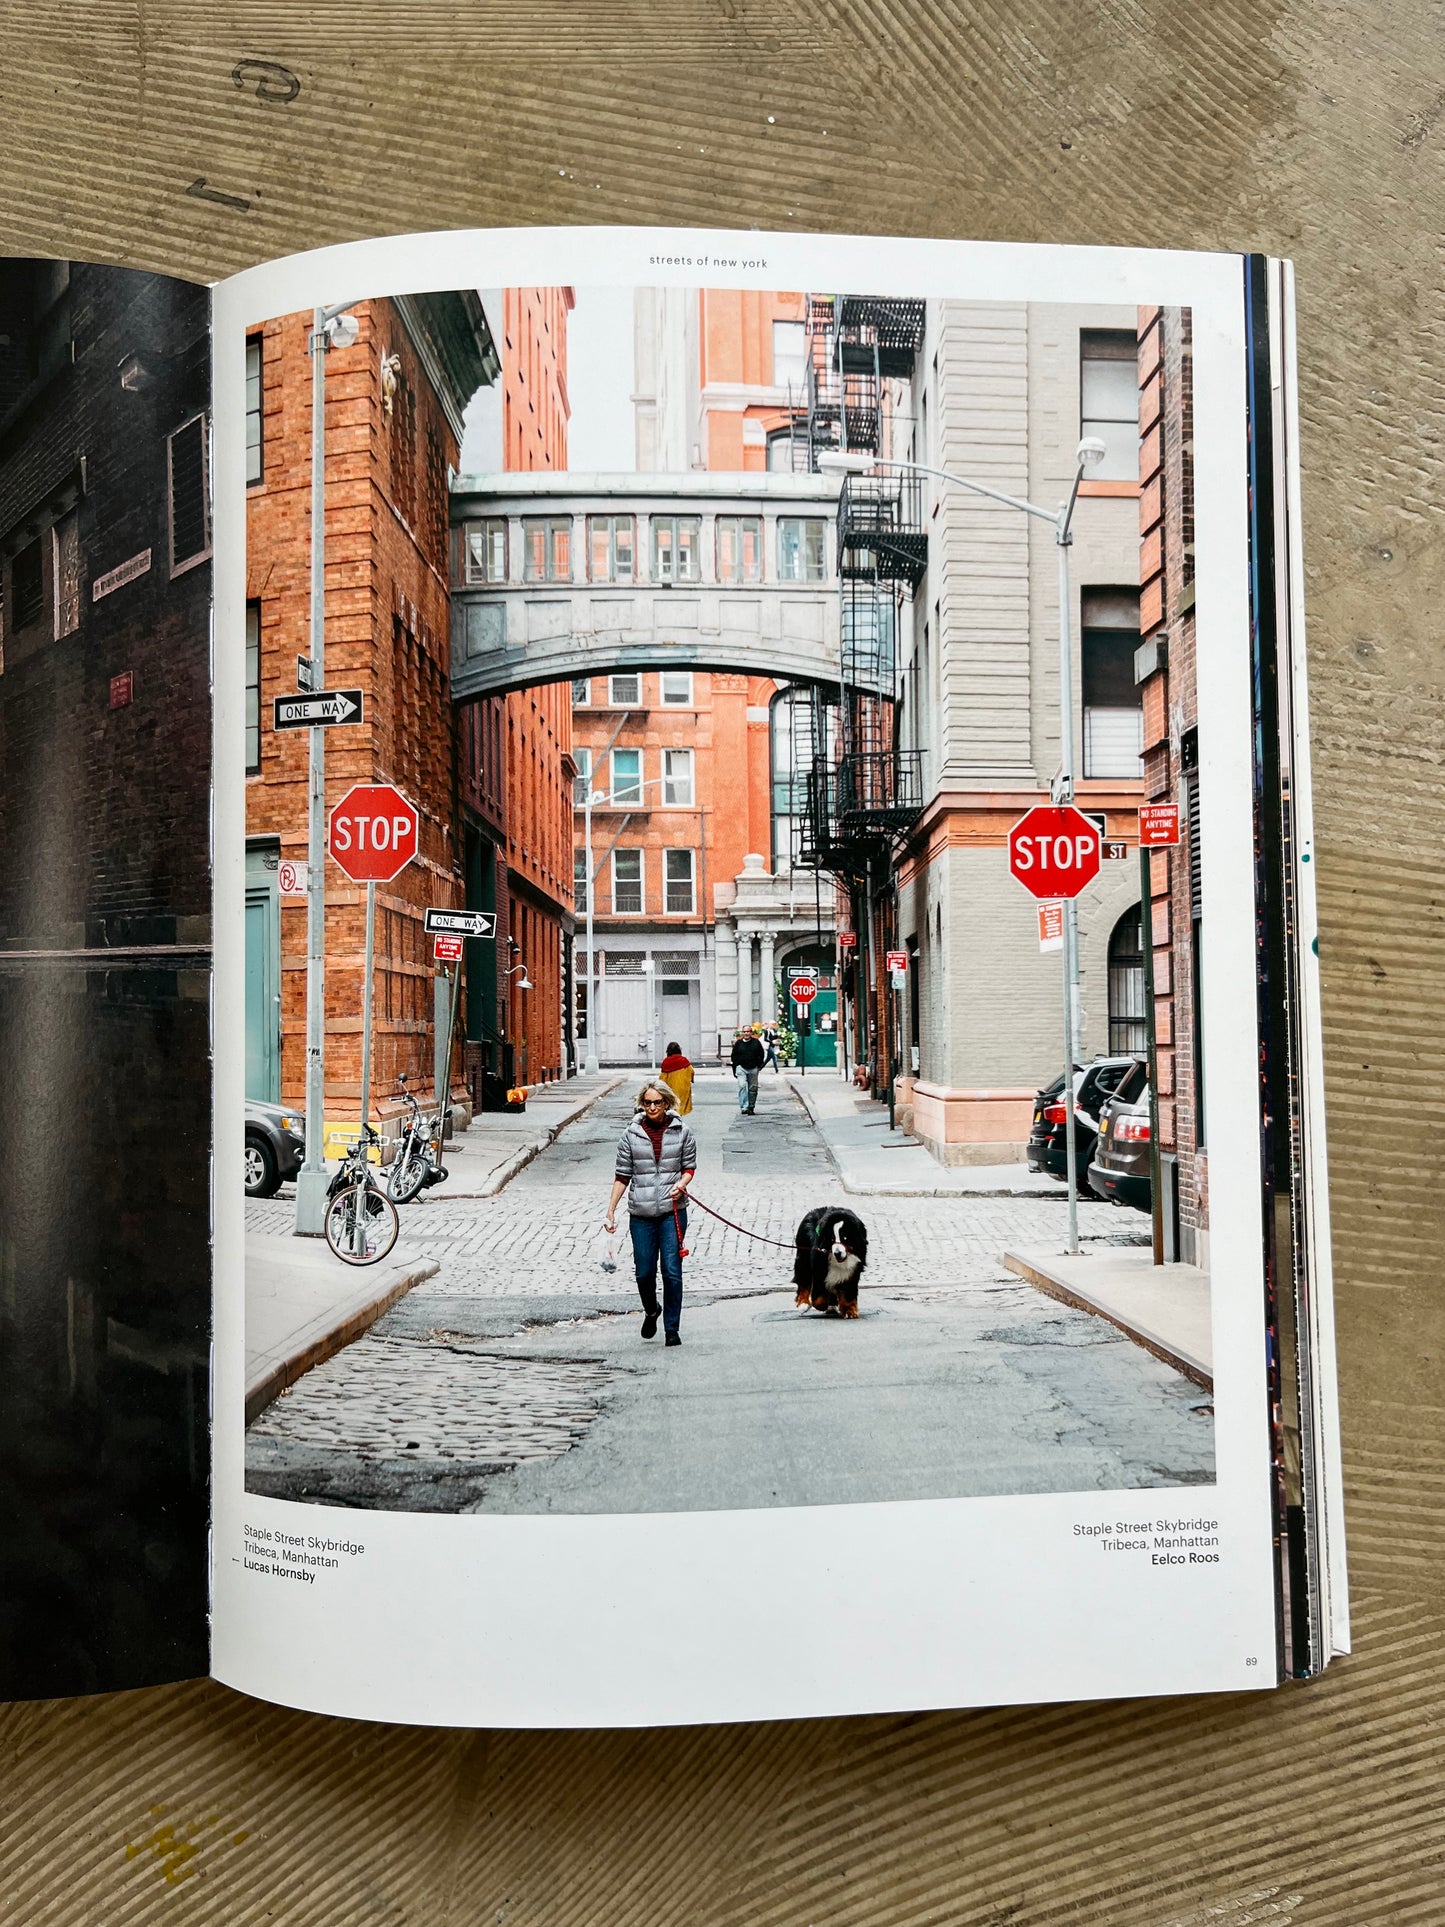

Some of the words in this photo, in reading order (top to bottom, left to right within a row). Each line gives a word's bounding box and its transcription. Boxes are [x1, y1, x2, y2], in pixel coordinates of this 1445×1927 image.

[649, 256, 692, 265] streets
[696, 256, 708, 266] of
[713, 258, 737, 267] new
[741, 259, 768, 269] york
[286, 704, 310, 719] ONE
[321, 701, 348, 716] WAY
[1140, 810, 1149, 819] NO
[1150, 808, 1177, 818] STANDING
[1145, 819, 1173, 829] ANYTIME
[334, 815, 412, 851] STOP
[1015, 835, 1095, 870] STOP
[1109, 844, 1125, 859] ST
[436, 916, 455, 927] ONE
[464, 919, 485, 929] WAY
[792, 985, 816, 996] STOP
[1072, 1522, 1113, 1537] Staple
[1115, 1521, 1153, 1534] Street
[1155, 1518, 1219, 1533] Skybridge
[244, 1524, 272, 1540] Staple
[274, 1531, 305, 1547] Street
[307, 1536, 365, 1555] Skybridge
[1101, 1538, 1150, 1551] Tribeca,
[1153, 1535, 1219, 1549] Manhattan
[244, 1540, 280, 1560] Tribeca,
[282, 1549, 340, 1568] Manhattan
[1151, 1553, 1186, 1565] Eelco
[1189, 1552, 1220, 1564] Roos
[244, 1557, 270, 1574] Lucas
[272, 1563, 316, 1584] Hornsby
[1246, 1657, 1258, 1667] 89
